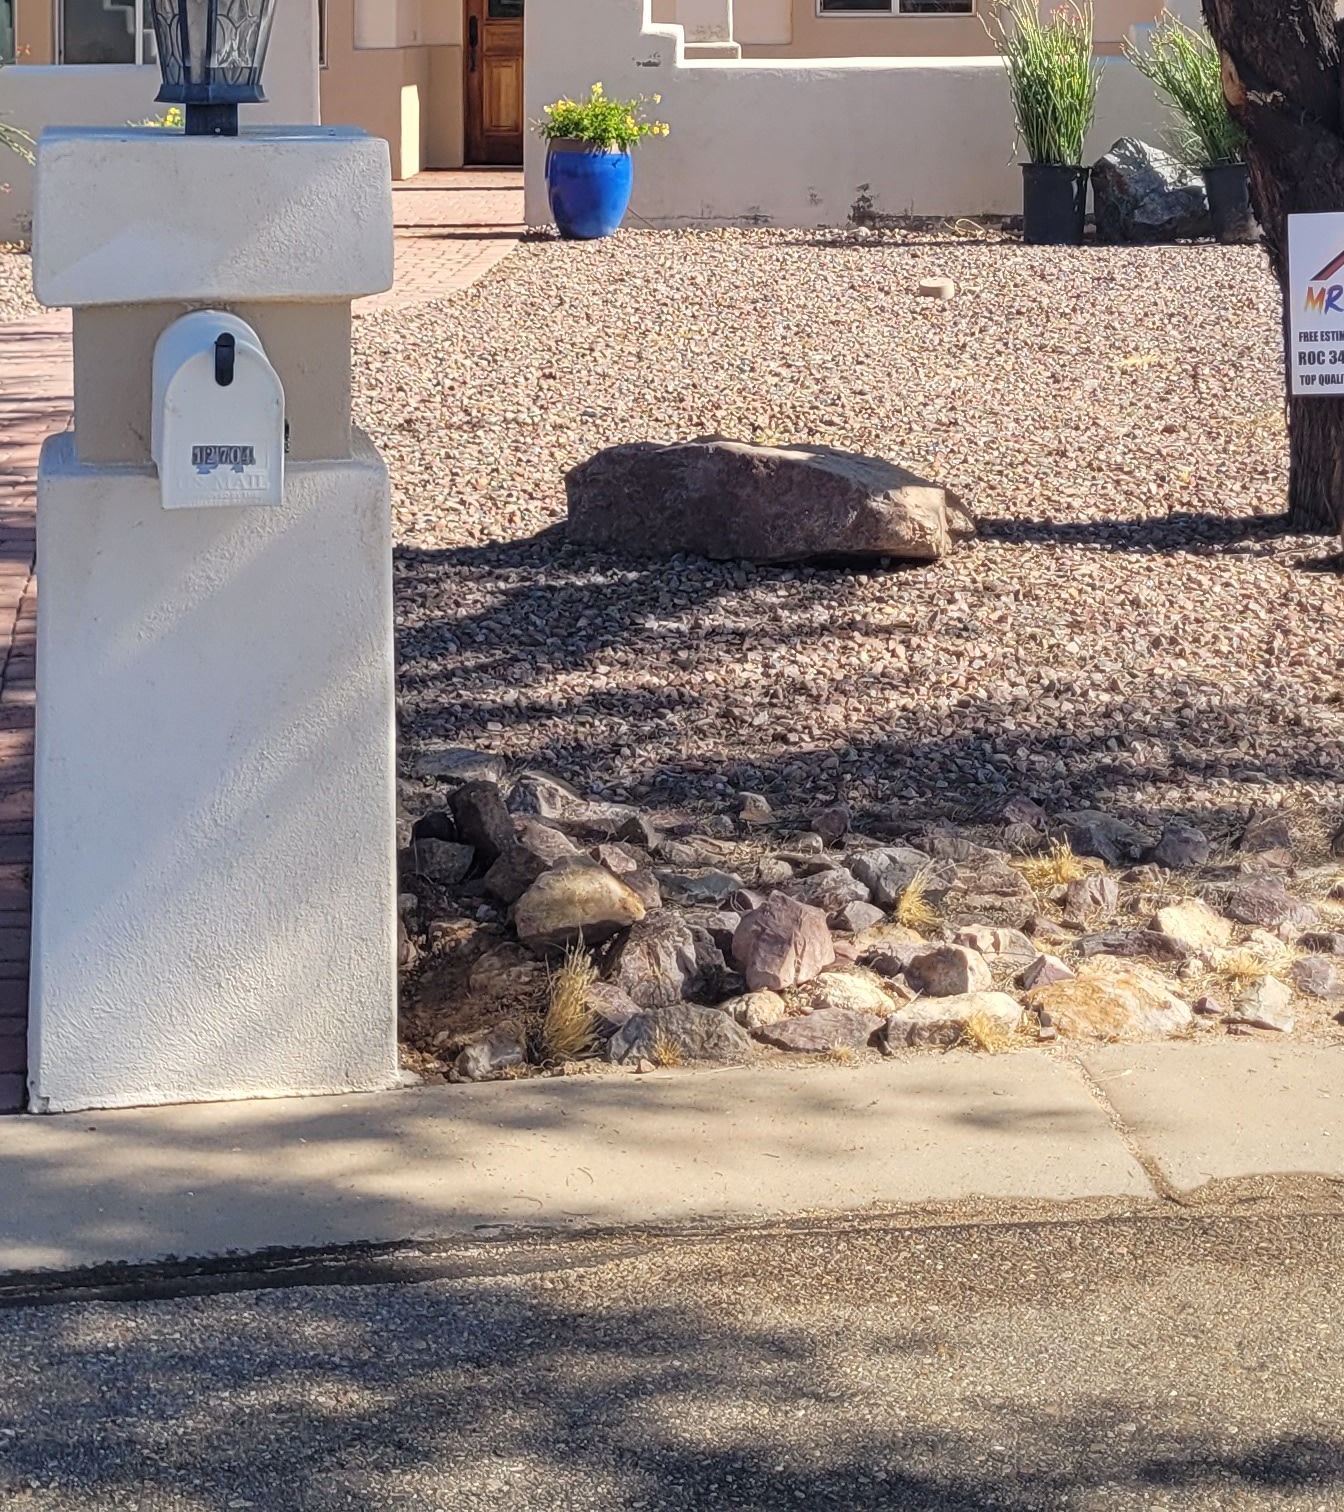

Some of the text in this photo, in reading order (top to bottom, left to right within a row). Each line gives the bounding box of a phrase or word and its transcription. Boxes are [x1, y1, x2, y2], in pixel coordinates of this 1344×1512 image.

[1304, 284, 1344, 314] MR
[1299, 331, 1319, 342] FREE
[1298, 351, 1326, 366] ROC
[1299, 375, 1318, 385] TOP
[194, 446, 253, 464] 12704
